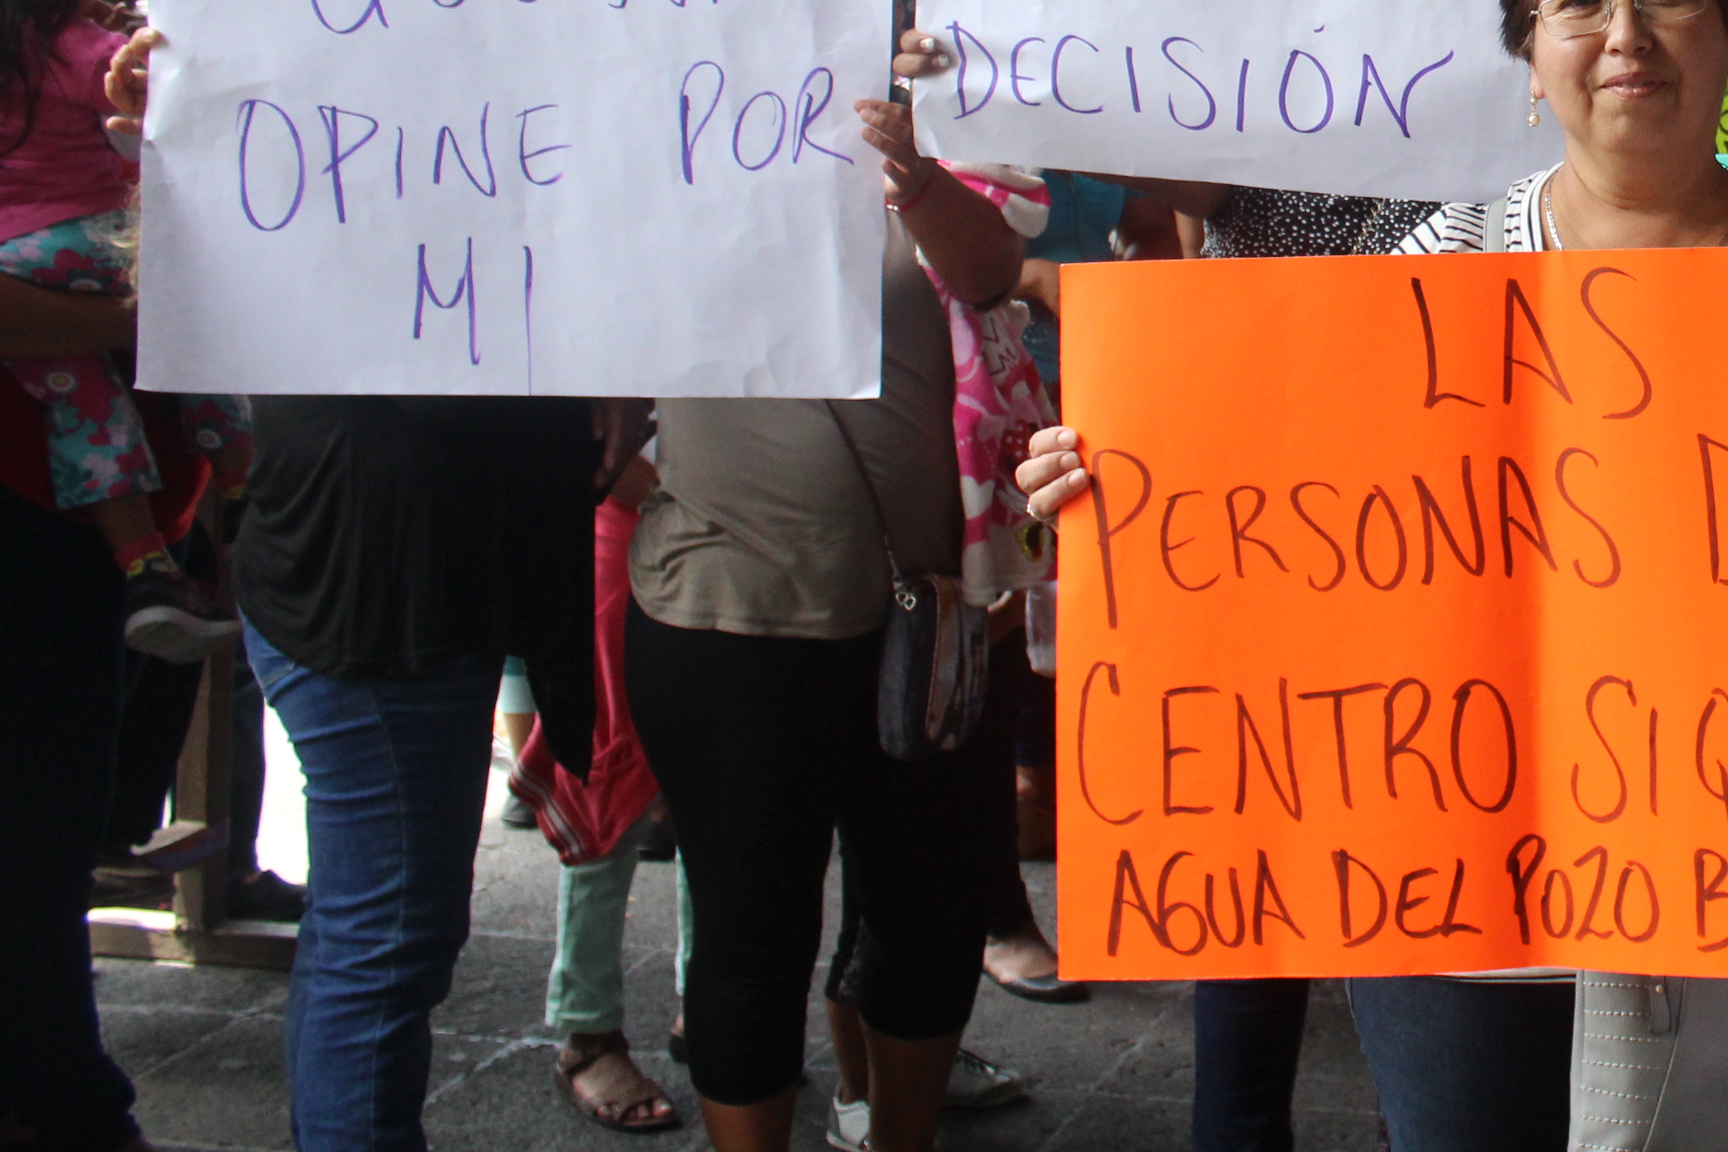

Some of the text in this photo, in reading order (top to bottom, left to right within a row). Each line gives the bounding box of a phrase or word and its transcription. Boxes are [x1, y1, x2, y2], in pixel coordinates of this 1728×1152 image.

[236, 60, 854, 232] OPINE POR
[953, 21, 1454, 138] DECISIÓN
[413, 236, 533, 396] MI
[1411, 266, 1654, 420] LAS
[1092, 448, 1621, 629] PERSONAS
[1078, 661, 1517, 825] CENTRO
[1573, 674, 1658, 824] SI
[1106, 849, 1301, 956] AGUA
[1333, 849, 1483, 947] DEL
[1505, 833, 1660, 946] POZO
